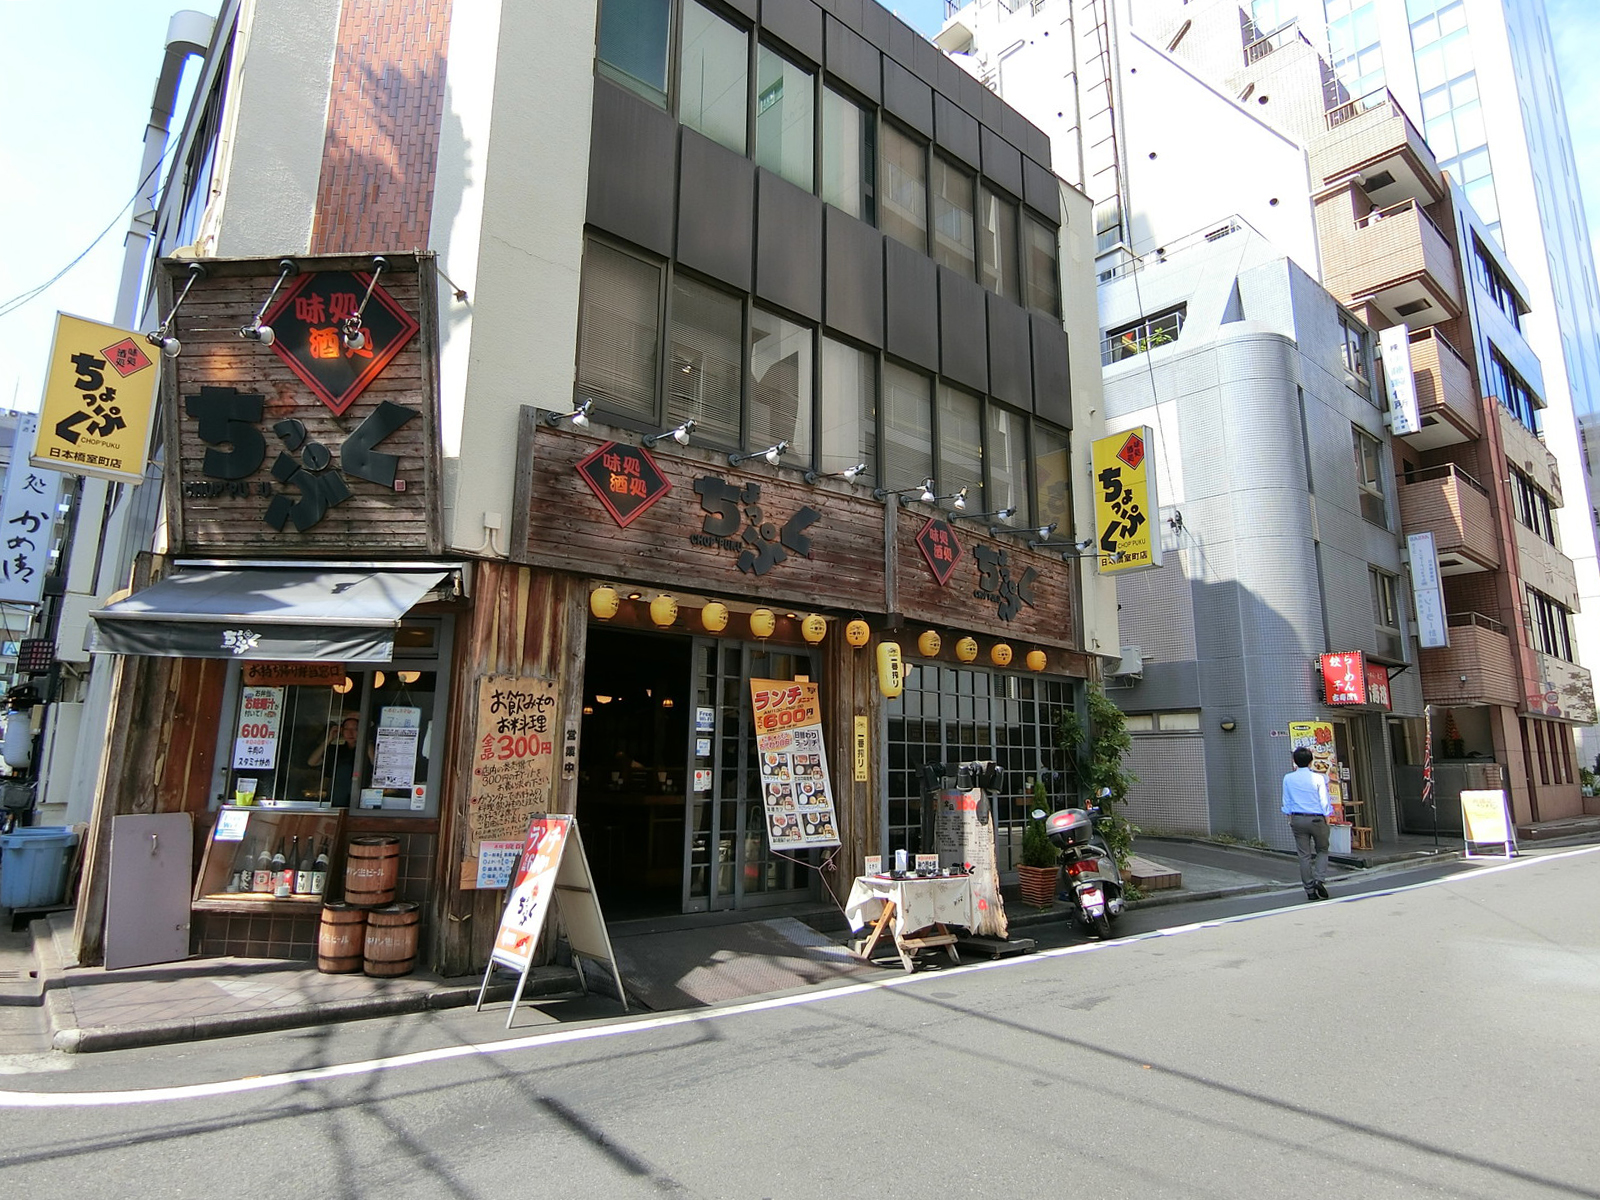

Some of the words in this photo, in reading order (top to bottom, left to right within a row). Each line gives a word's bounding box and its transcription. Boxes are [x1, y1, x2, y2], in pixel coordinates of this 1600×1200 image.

[295, 292, 359, 324] 味処
[55, 352, 127, 445] ちょっぷく
[50, 447, 123, 469] 日本橋室町店
[603, 453, 640, 476] 味処
[610, 473, 647, 498] 酒処
[1098, 467, 1147, 553] ちょっぷく
[693, 476, 821, 576] ちょっぷく
[1101, 550, 1148, 567] 日橋室町店
[890, 658, 899, 688] 一番搾り
[1329, 655, 1344, 691] 餃子
[1344, 655, 1355, 691] らーめん
[490, 689, 555, 717] お飲みもの
[755, 685, 802, 712] ランチ
[241, 723, 275, 739] 600円
[497, 714, 548, 736] お料理
[763, 707, 814, 729] 600円
[480, 733, 496, 761] 全品
[497, 734, 552, 760] 300円
[564, 729, 577, 773] 営業中
[528, 826, 562, 853] ランチ
